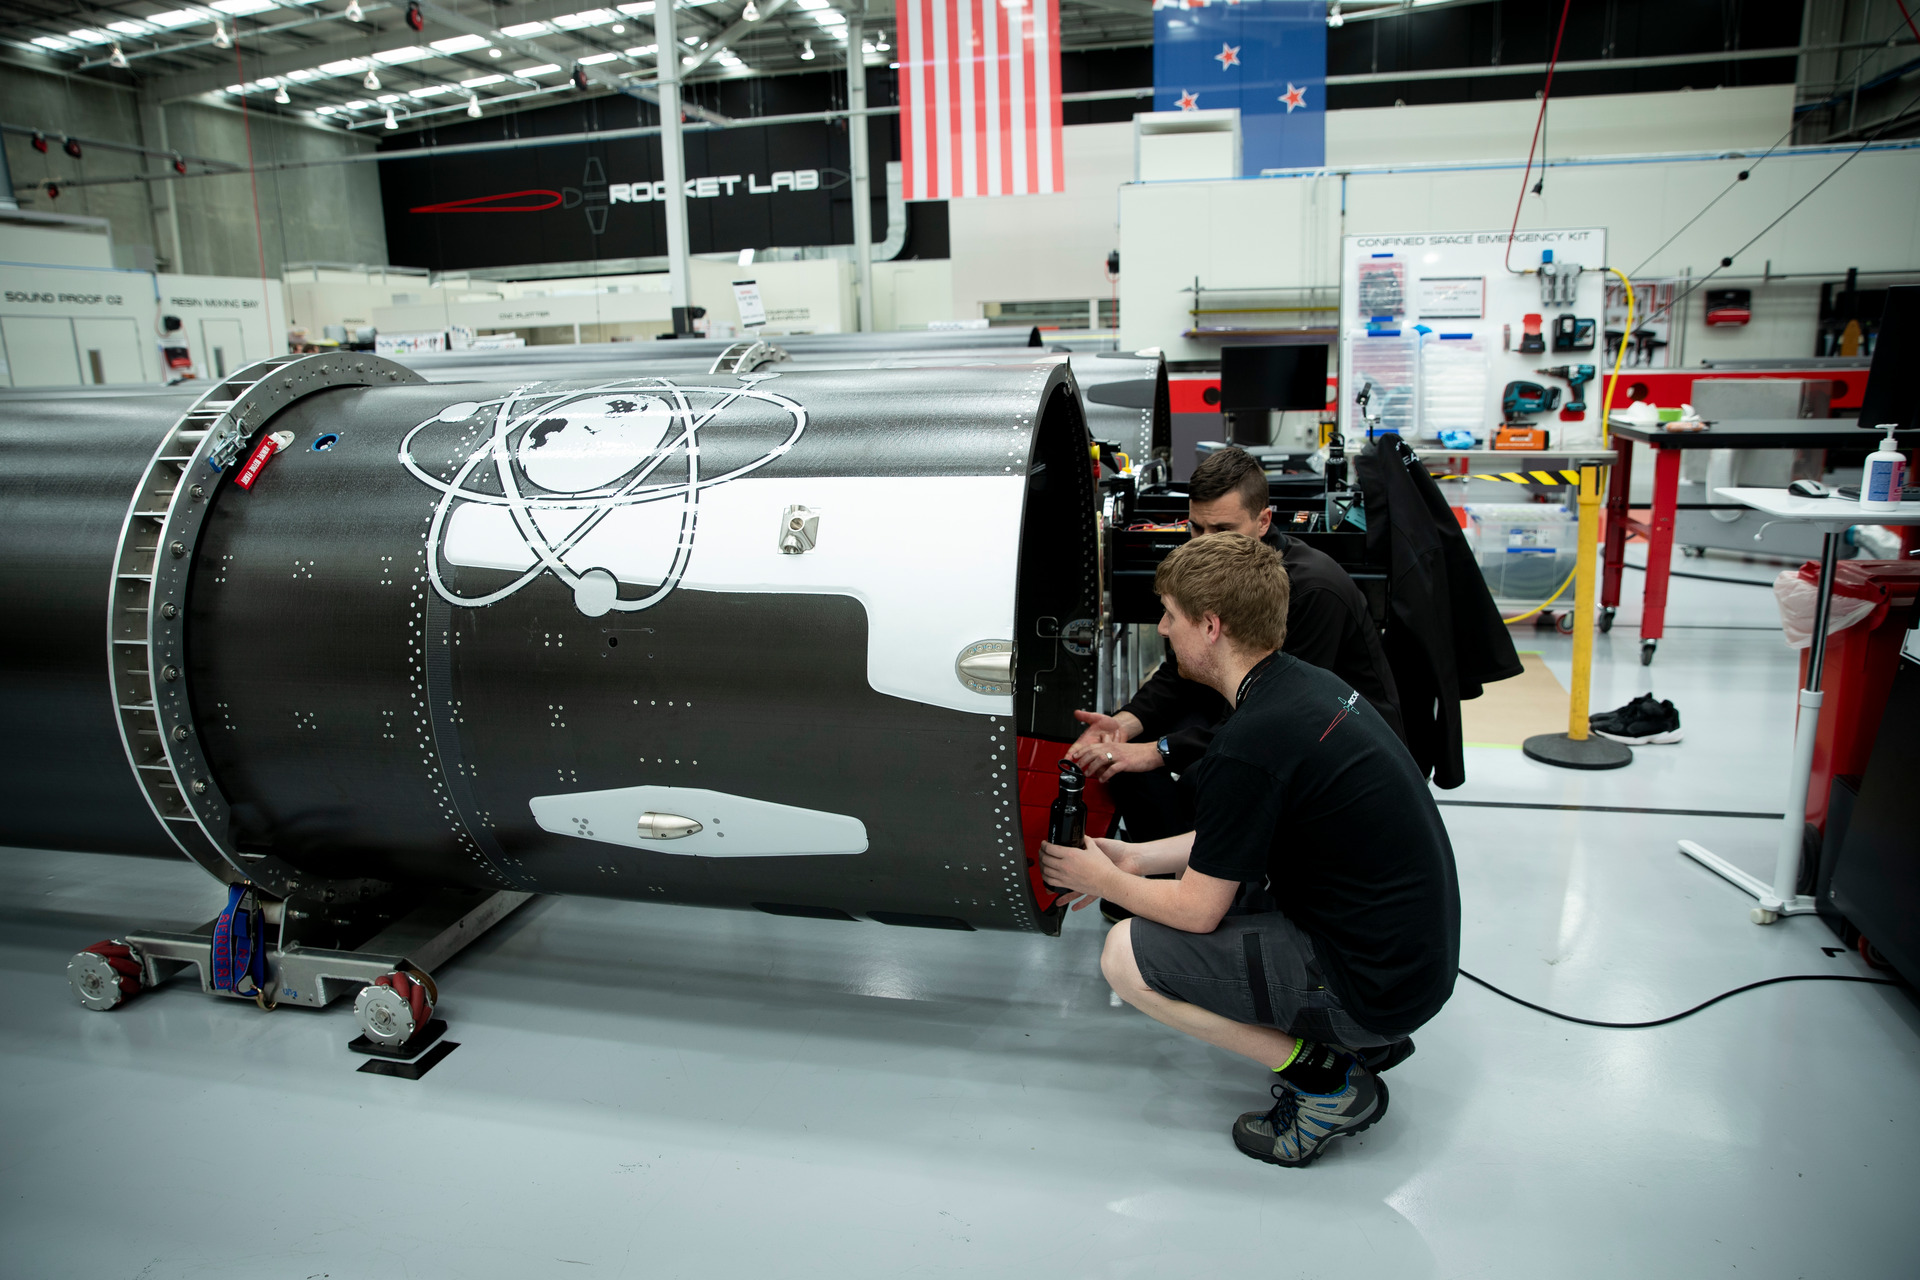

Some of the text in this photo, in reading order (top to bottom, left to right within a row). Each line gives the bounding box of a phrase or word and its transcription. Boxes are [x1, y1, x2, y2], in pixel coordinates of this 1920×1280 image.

[609, 169, 820, 204] ROCKET LAB
[1357, 231, 1590, 247] CONFINED SPACE EMERGENCY KIT
[4, 291, 56, 303] SOUND
[58, 293, 103, 304] PROOF
[242, 299, 259, 309] BAY
[1348, 690, 1360, 706] ROCK
